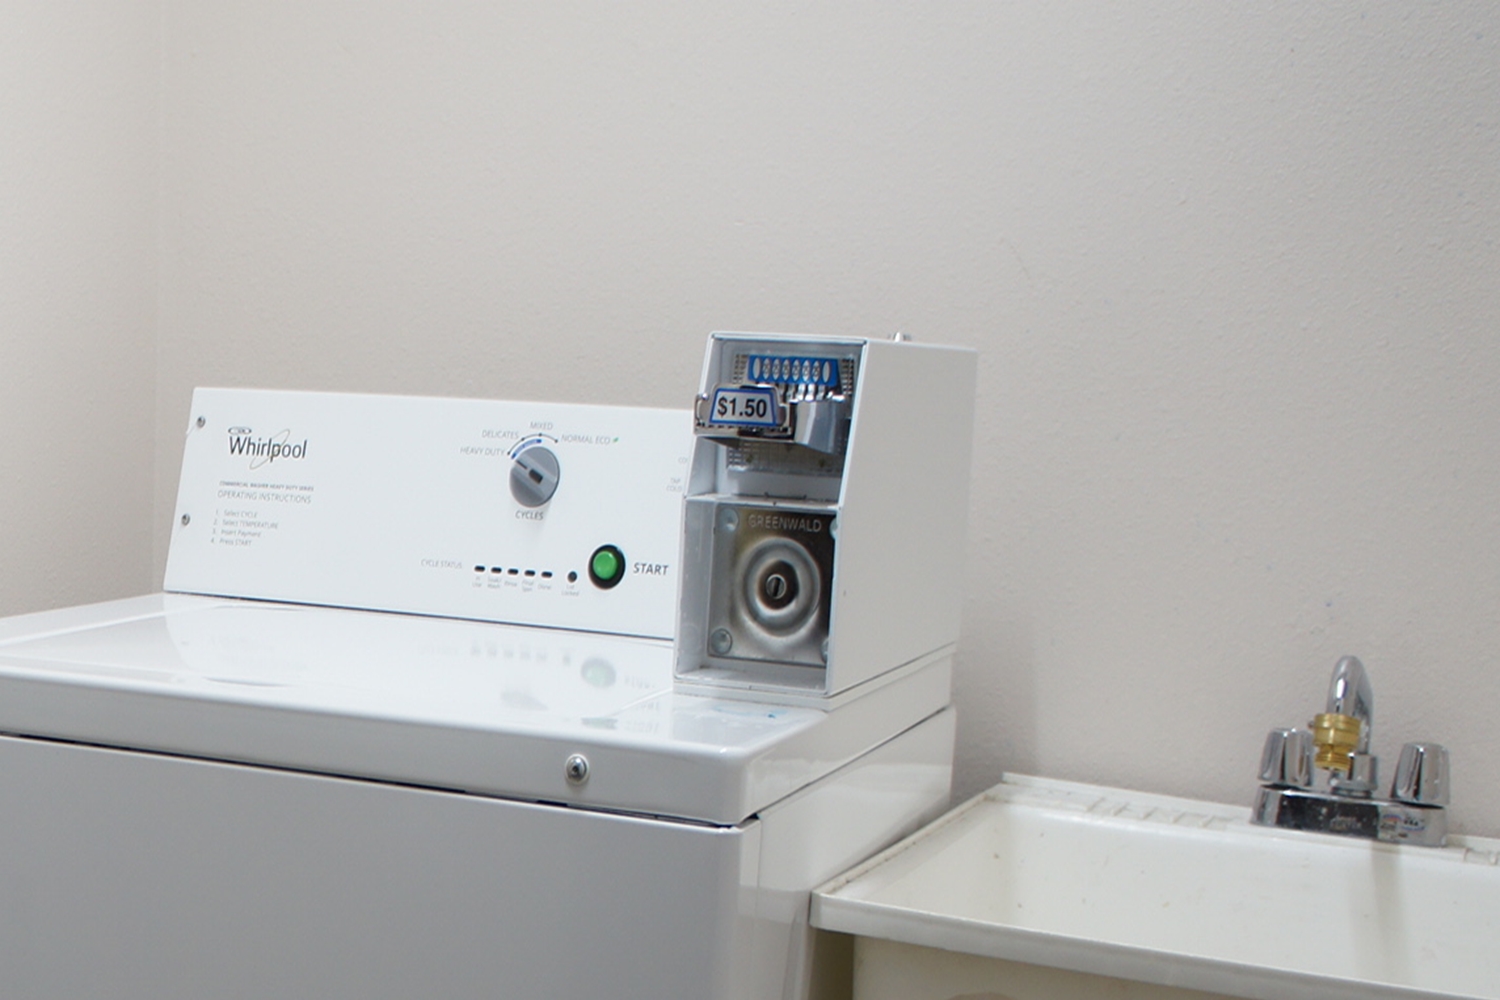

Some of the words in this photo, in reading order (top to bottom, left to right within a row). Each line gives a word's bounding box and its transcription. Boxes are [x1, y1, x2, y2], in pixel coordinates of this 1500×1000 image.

[717, 396, 767, 418] $1.50
[529, 421, 553, 431] MIXED
[481, 430, 519, 440] DELICATES
[561, 434, 593, 444] NORMAL
[595, 436, 611, 445] ECO
[228, 435, 308, 464] Whirlpool
[461, 446, 484, 456] HEAVY
[485, 447, 506, 456] DUTY
[217, 490, 258, 500] OPERATING
[259, 493, 312, 504] INSTRUCTIONS
[515, 509, 544, 520] CYCLES
[748, 513, 822, 533] GREENWALD
[420, 559, 439, 568] CYCLE
[440, 560, 463, 570] STATUS
[632, 562, 669, 576] START
